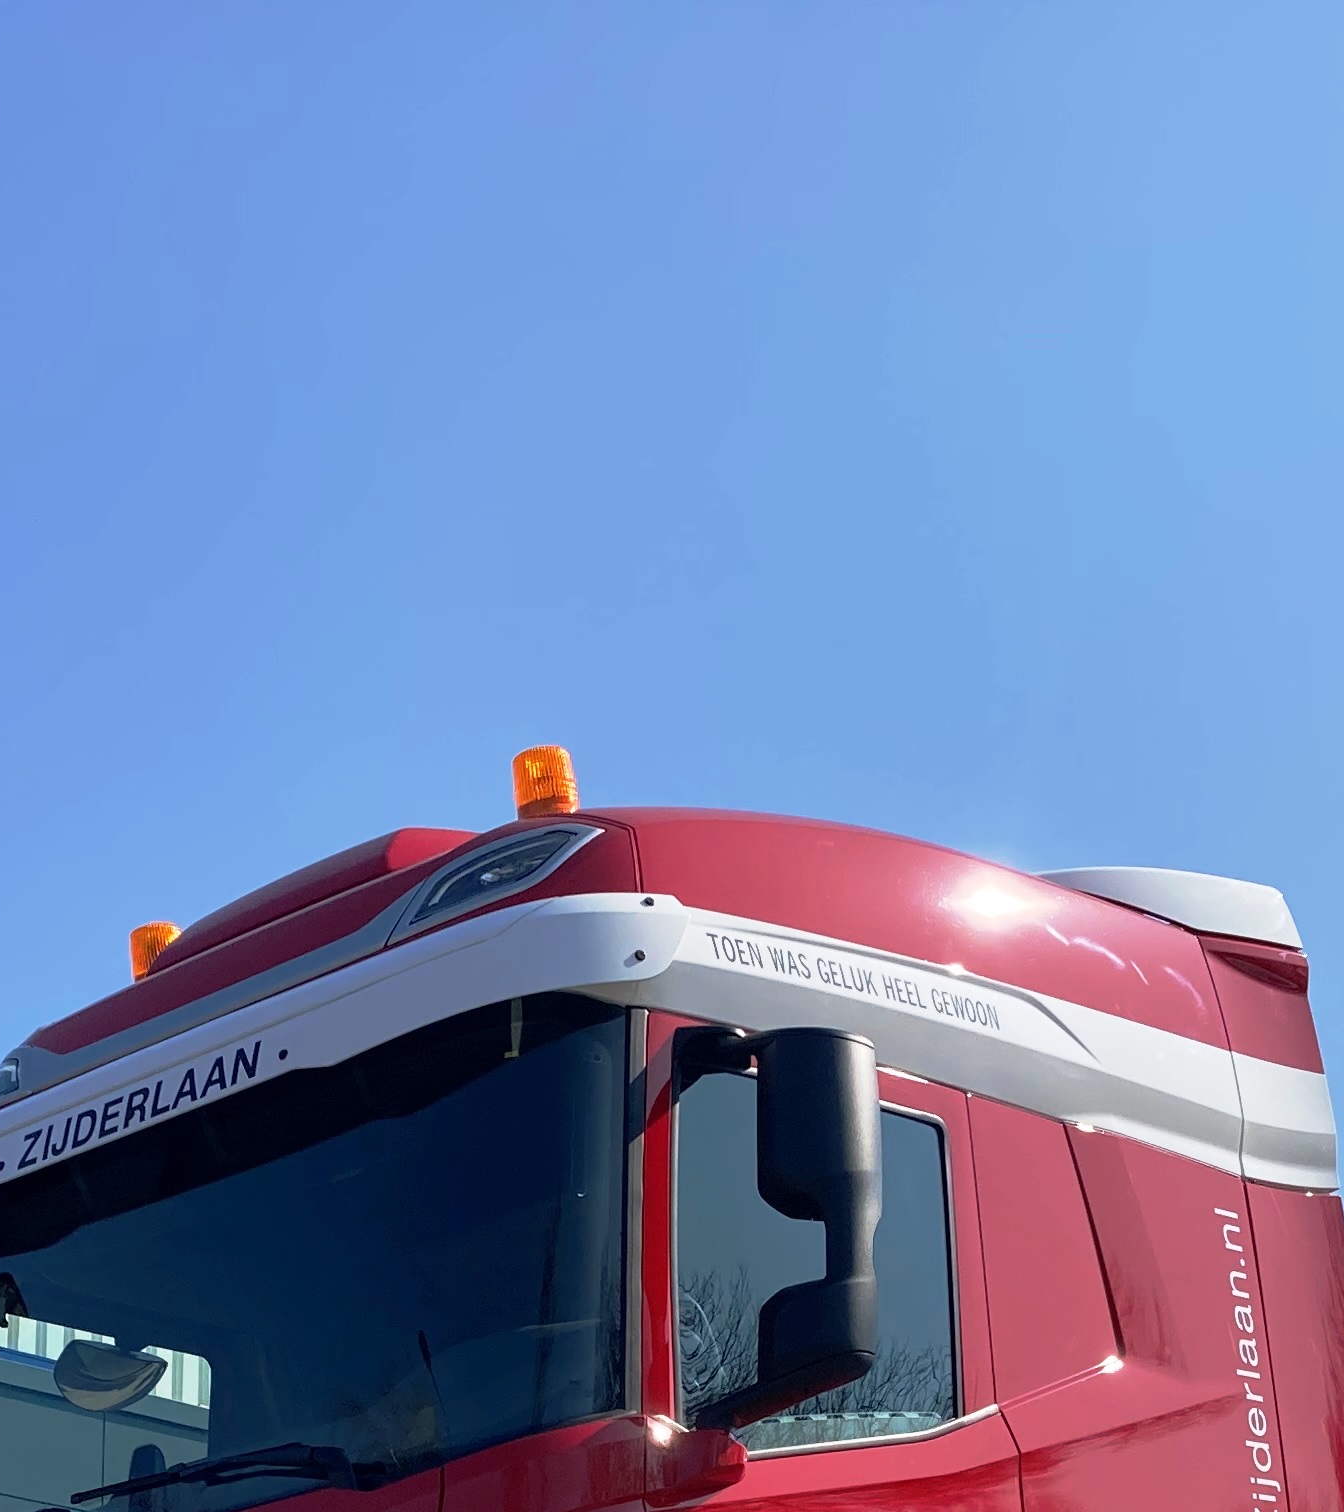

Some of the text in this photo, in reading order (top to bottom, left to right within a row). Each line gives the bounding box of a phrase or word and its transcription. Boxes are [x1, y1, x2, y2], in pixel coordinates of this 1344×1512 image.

[706, 932, 1000, 1030] TOEN WAS GELUK HEEL GEWOON
[17, 1040, 262, 1170] ZIJDERLAAN
